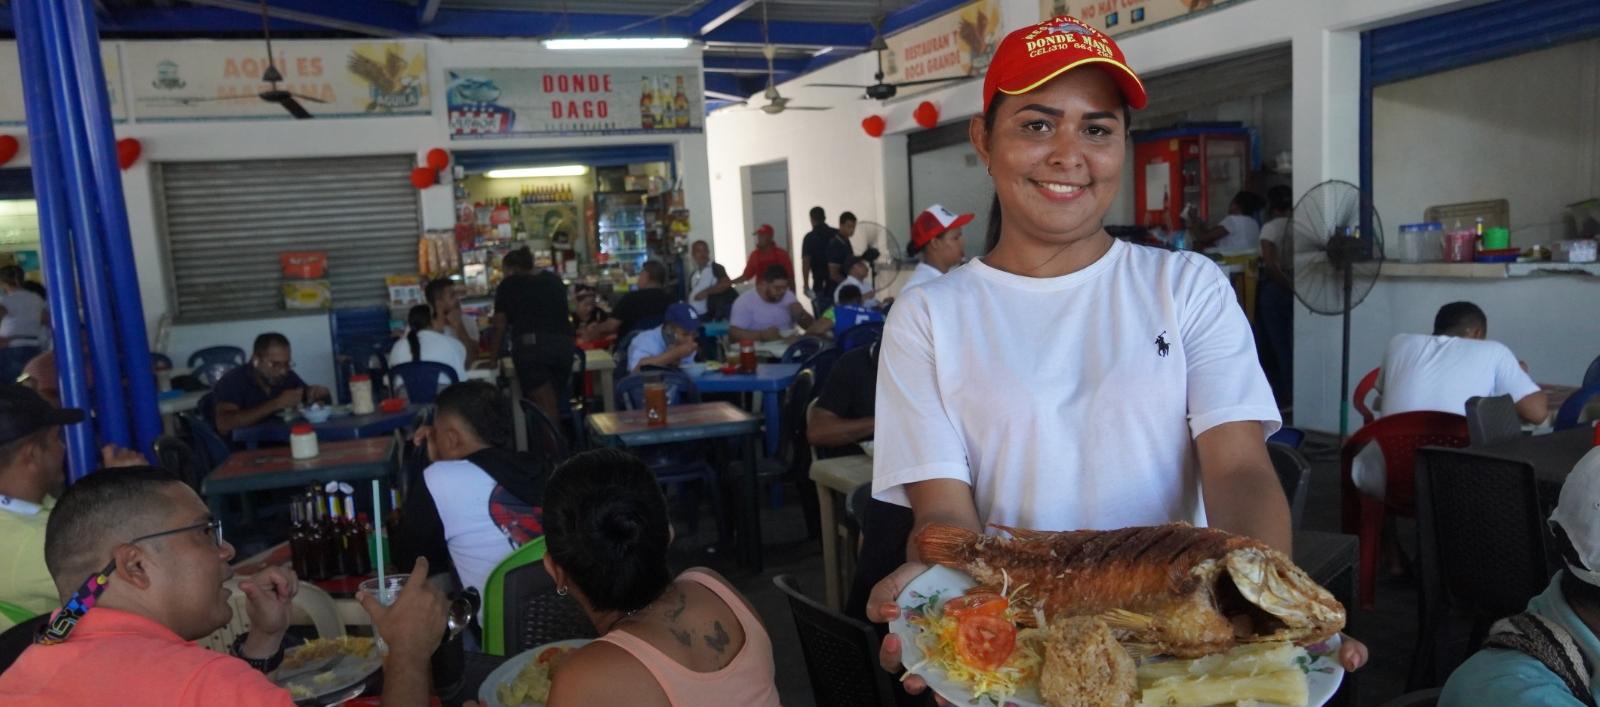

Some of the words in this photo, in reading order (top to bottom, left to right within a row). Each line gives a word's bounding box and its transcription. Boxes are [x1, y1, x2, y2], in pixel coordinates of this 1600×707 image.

[1026, 33, 1076, 52] DONDE
[297, 57, 325, 77] ES
[927, 50, 960, 73] GRANDE
[543, 74, 613, 94] DONDE
[551, 100, 609, 119] DAGO
